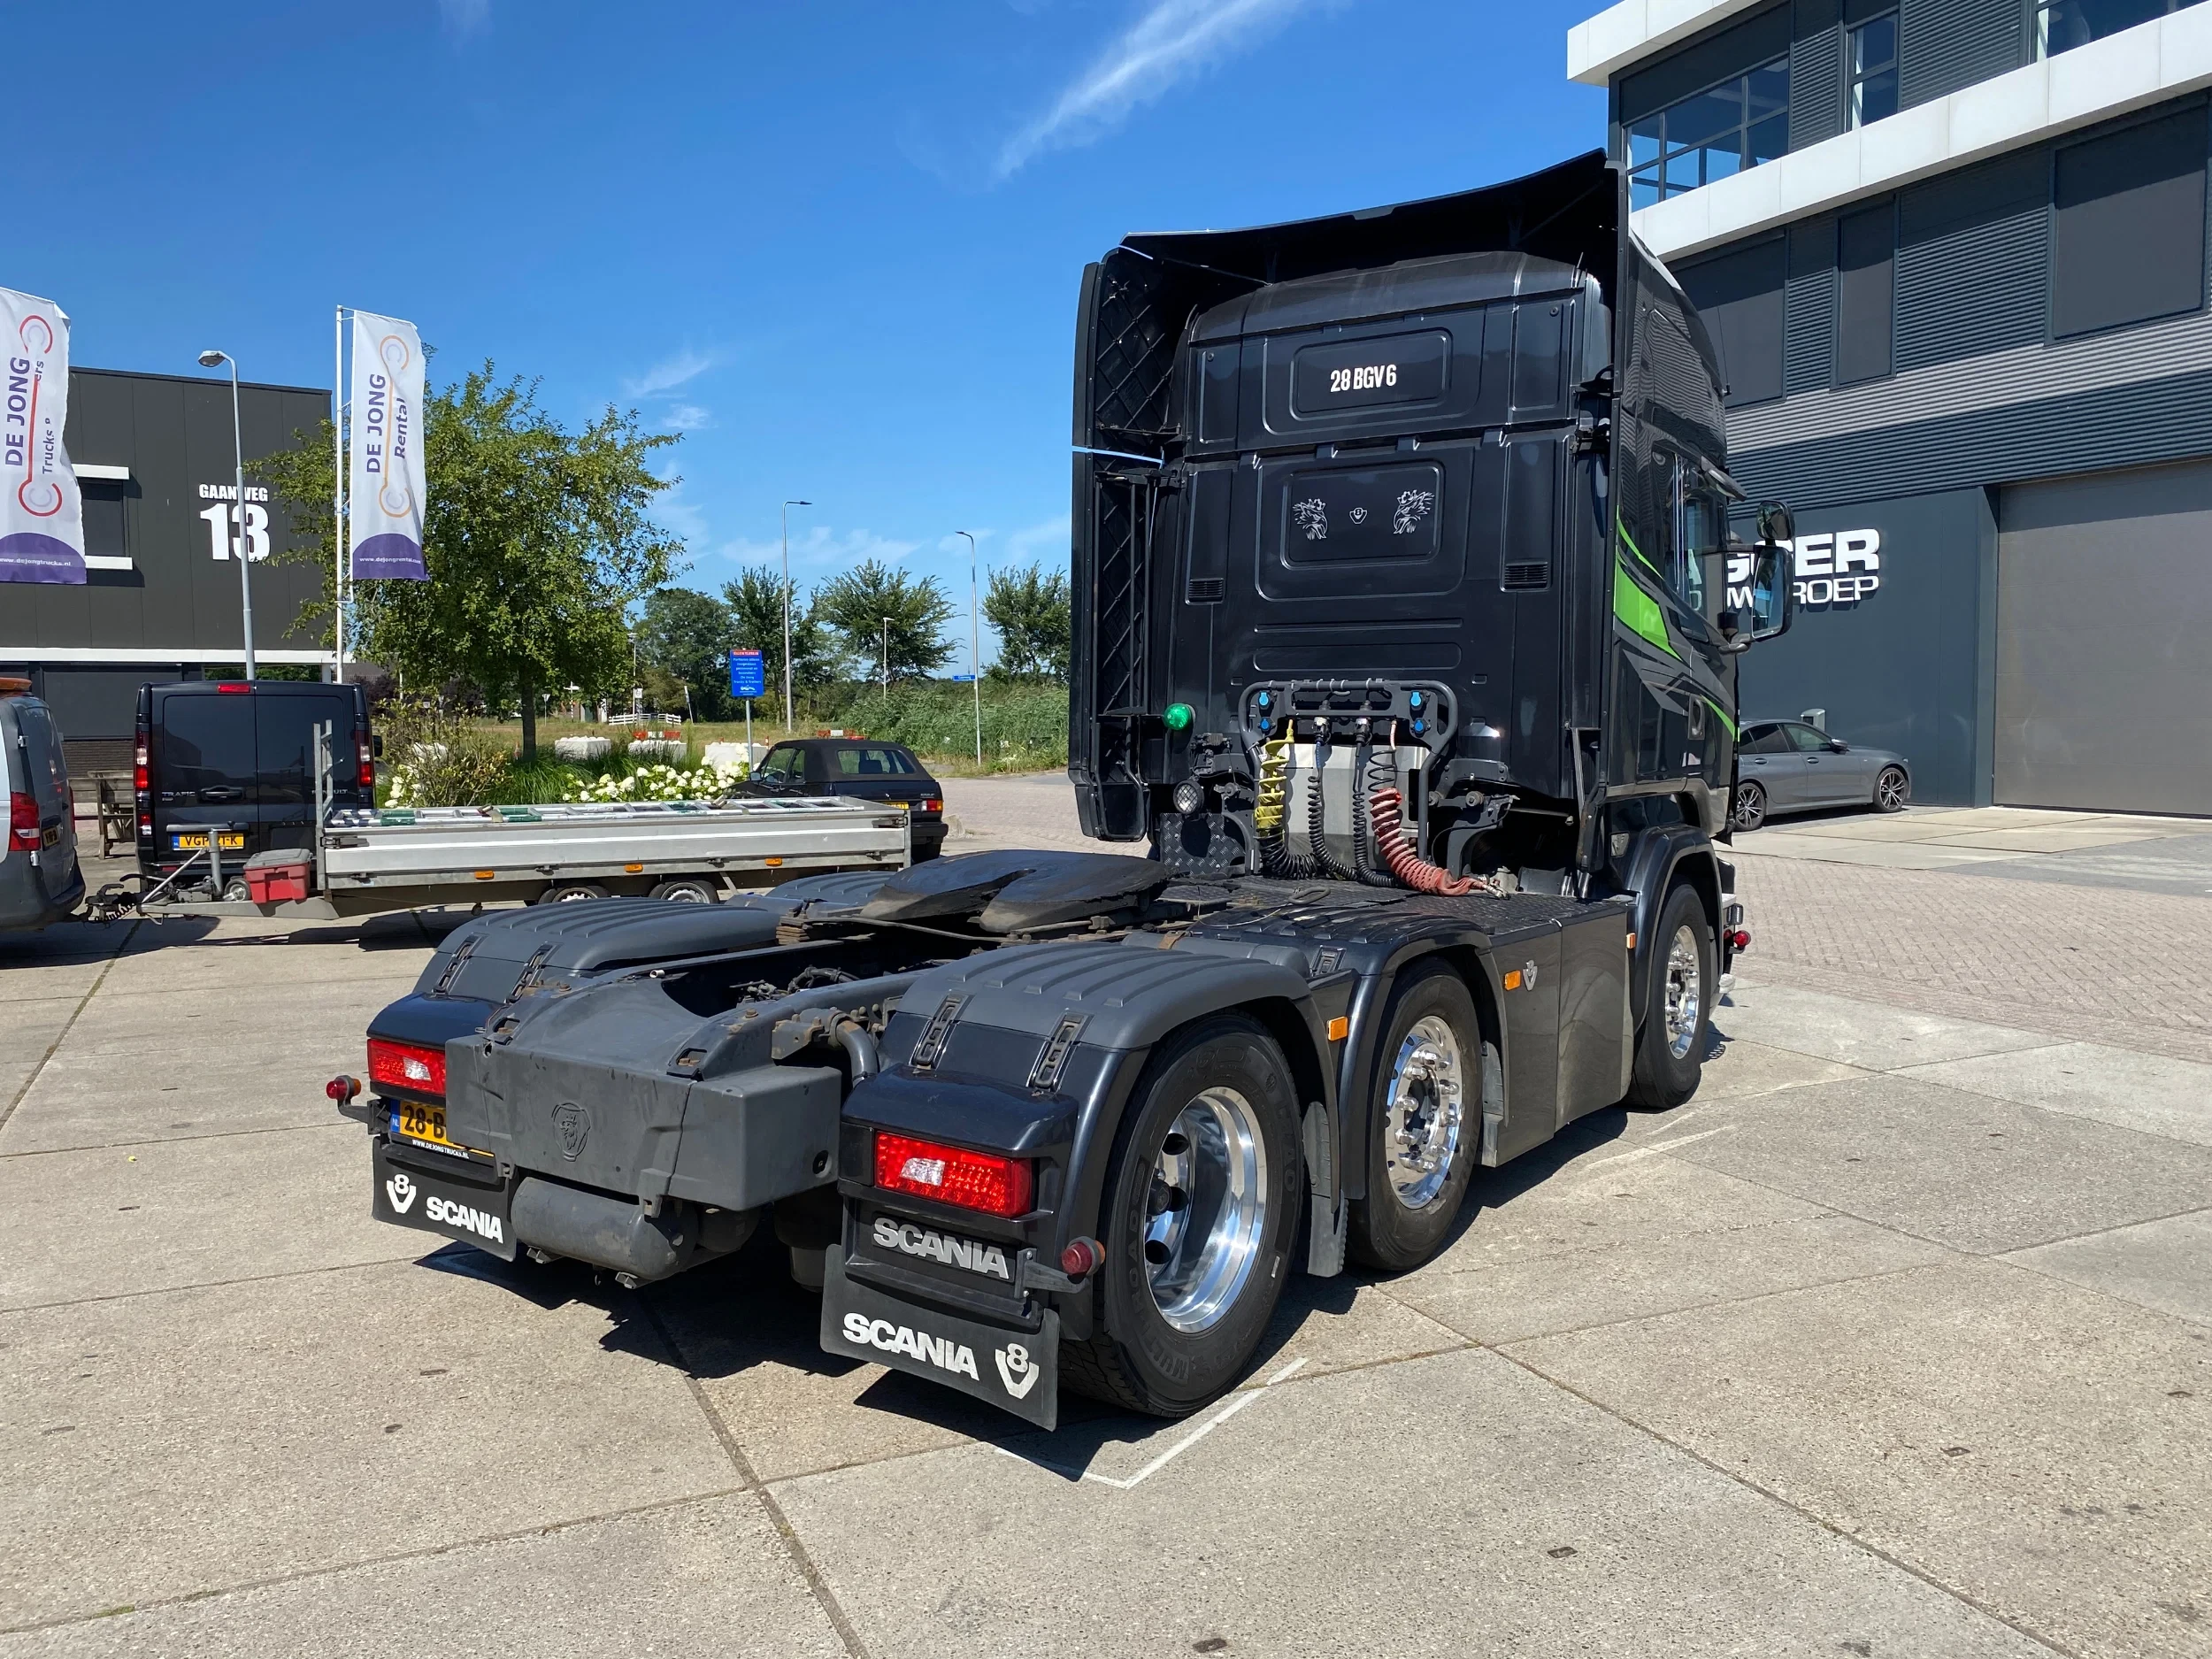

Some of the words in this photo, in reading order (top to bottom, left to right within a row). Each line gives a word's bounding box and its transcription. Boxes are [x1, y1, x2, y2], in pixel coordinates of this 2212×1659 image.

[6, 357, 30, 426] JONG
[367, 373, 387, 436] JONG
[1330, 368, 1351, 392] 28
[5, 433, 24, 466] DE
[394, 397, 408, 459] Rental
[366, 443, 381, 473] DE
[200, 503, 271, 563] 13
[392, 1118, 399, 1127] NL
[411, 1139, 470, 1159] WWW.DEJONGTRUCKS.NL
[426, 1195, 503, 1244] SCANIA
[872, 1217, 1010, 1280] SCANIA
[842, 1312, 980, 1382] SCANIA
